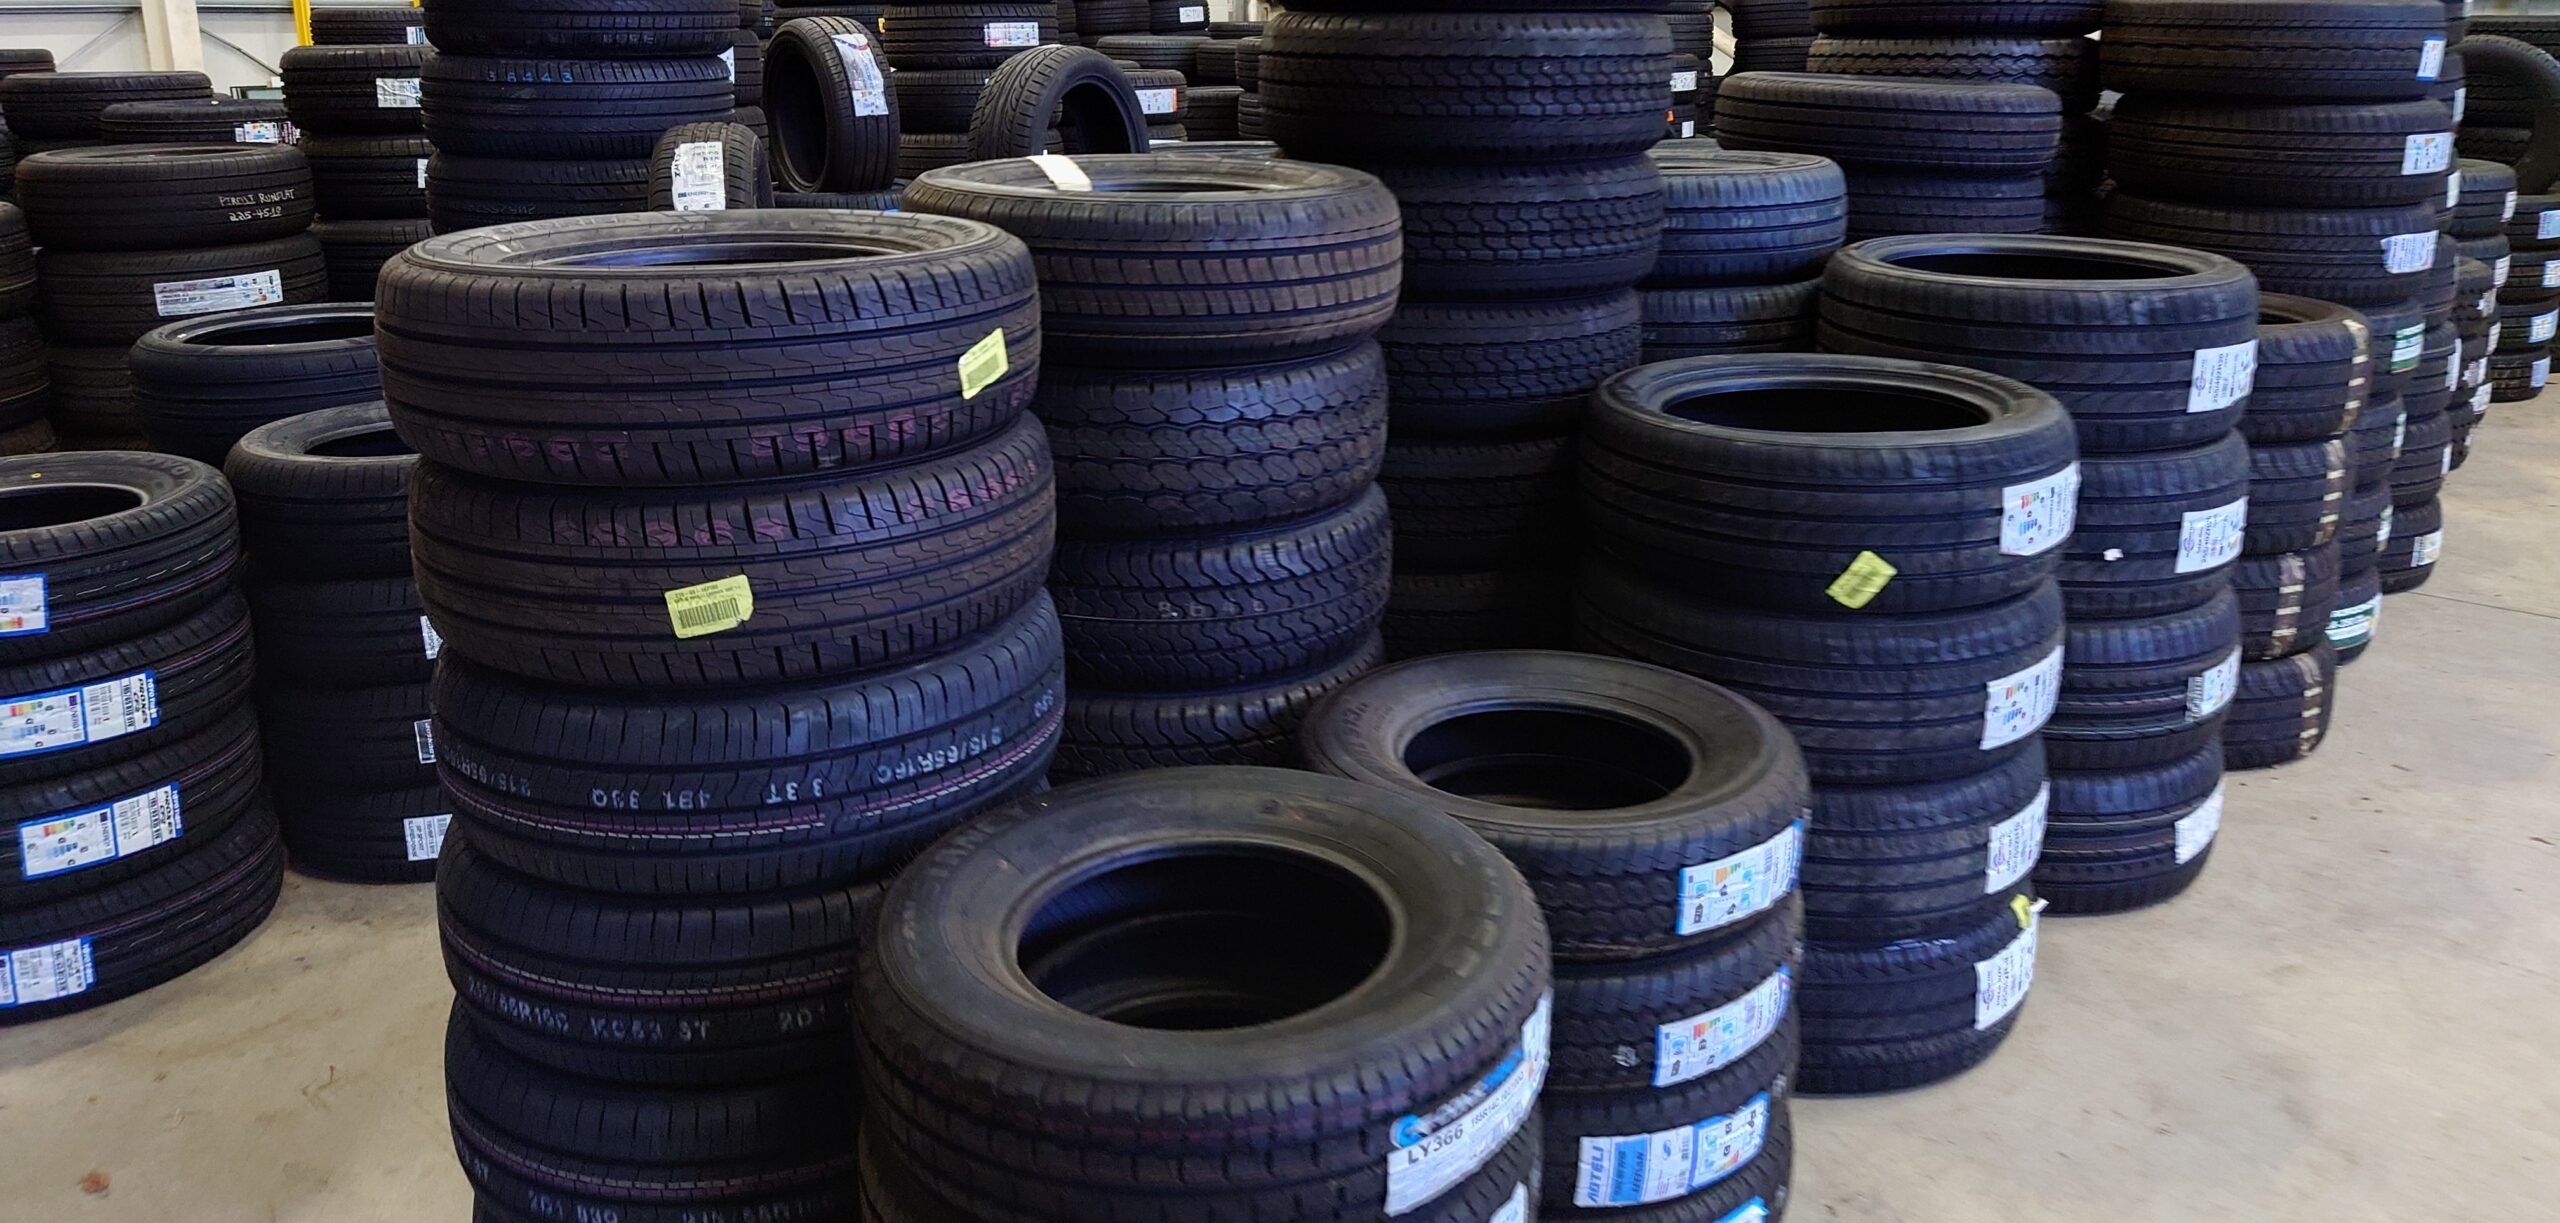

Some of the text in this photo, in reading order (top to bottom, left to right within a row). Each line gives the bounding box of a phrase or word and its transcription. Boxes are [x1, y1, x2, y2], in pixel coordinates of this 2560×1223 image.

[147, 677, 155, 698] TOYO
[163, 789, 173, 835] PROXES
[416, 833, 424, 850] SPORT
[1407, 1124, 1464, 1166] LY366
